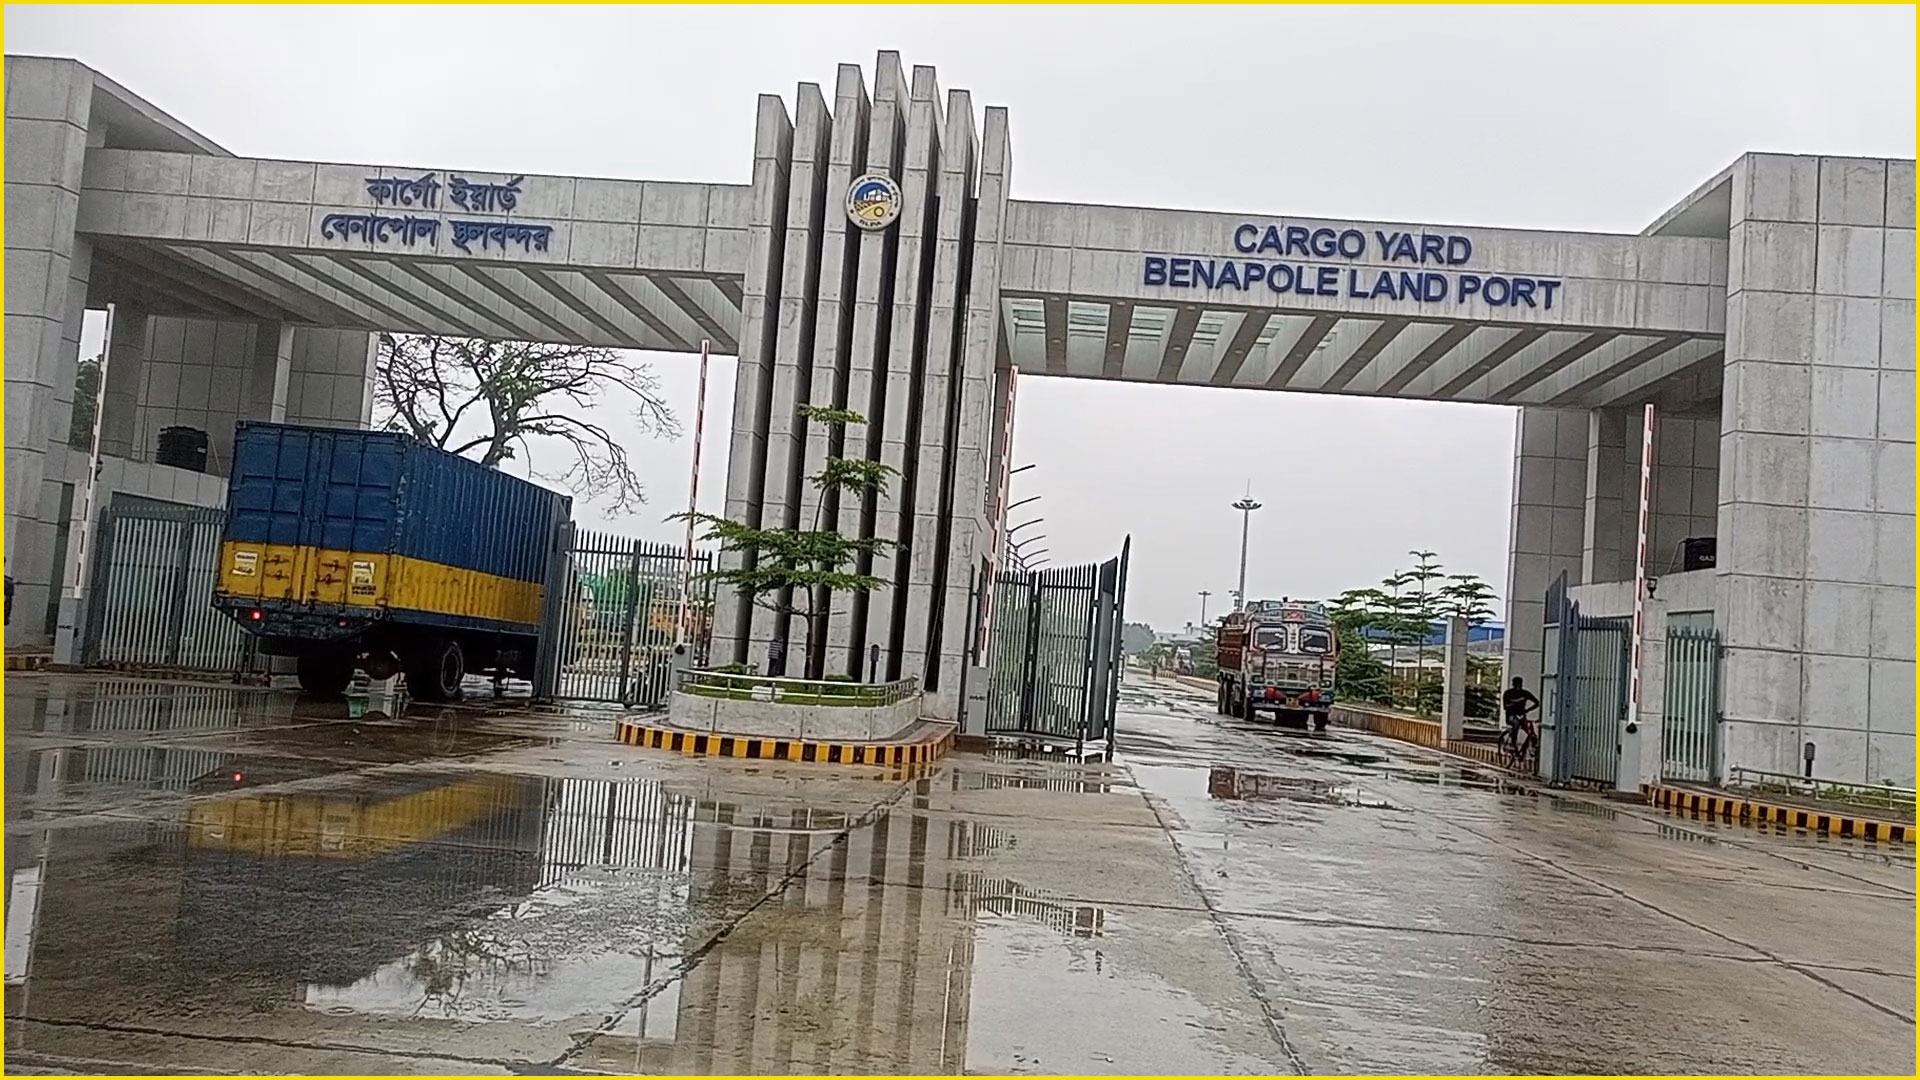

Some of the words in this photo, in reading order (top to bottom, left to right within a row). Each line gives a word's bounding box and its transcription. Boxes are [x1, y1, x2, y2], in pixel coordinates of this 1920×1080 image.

[364, 172, 442, 209] কার্গো
[448, 173, 525, 212] ইয়ার্ড
[321, 213, 441, 248] বেনাপোল
[448, 218, 554, 255] স্থলবন্দর
[1234, 223, 1366, 258] CARGO
[1376, 231, 1472, 265] YARD
[1143, 256, 1339, 296] BENAPOLE
[1349, 270, 1448, 301] LAND
[1458, 275, 1561, 309] PORT
